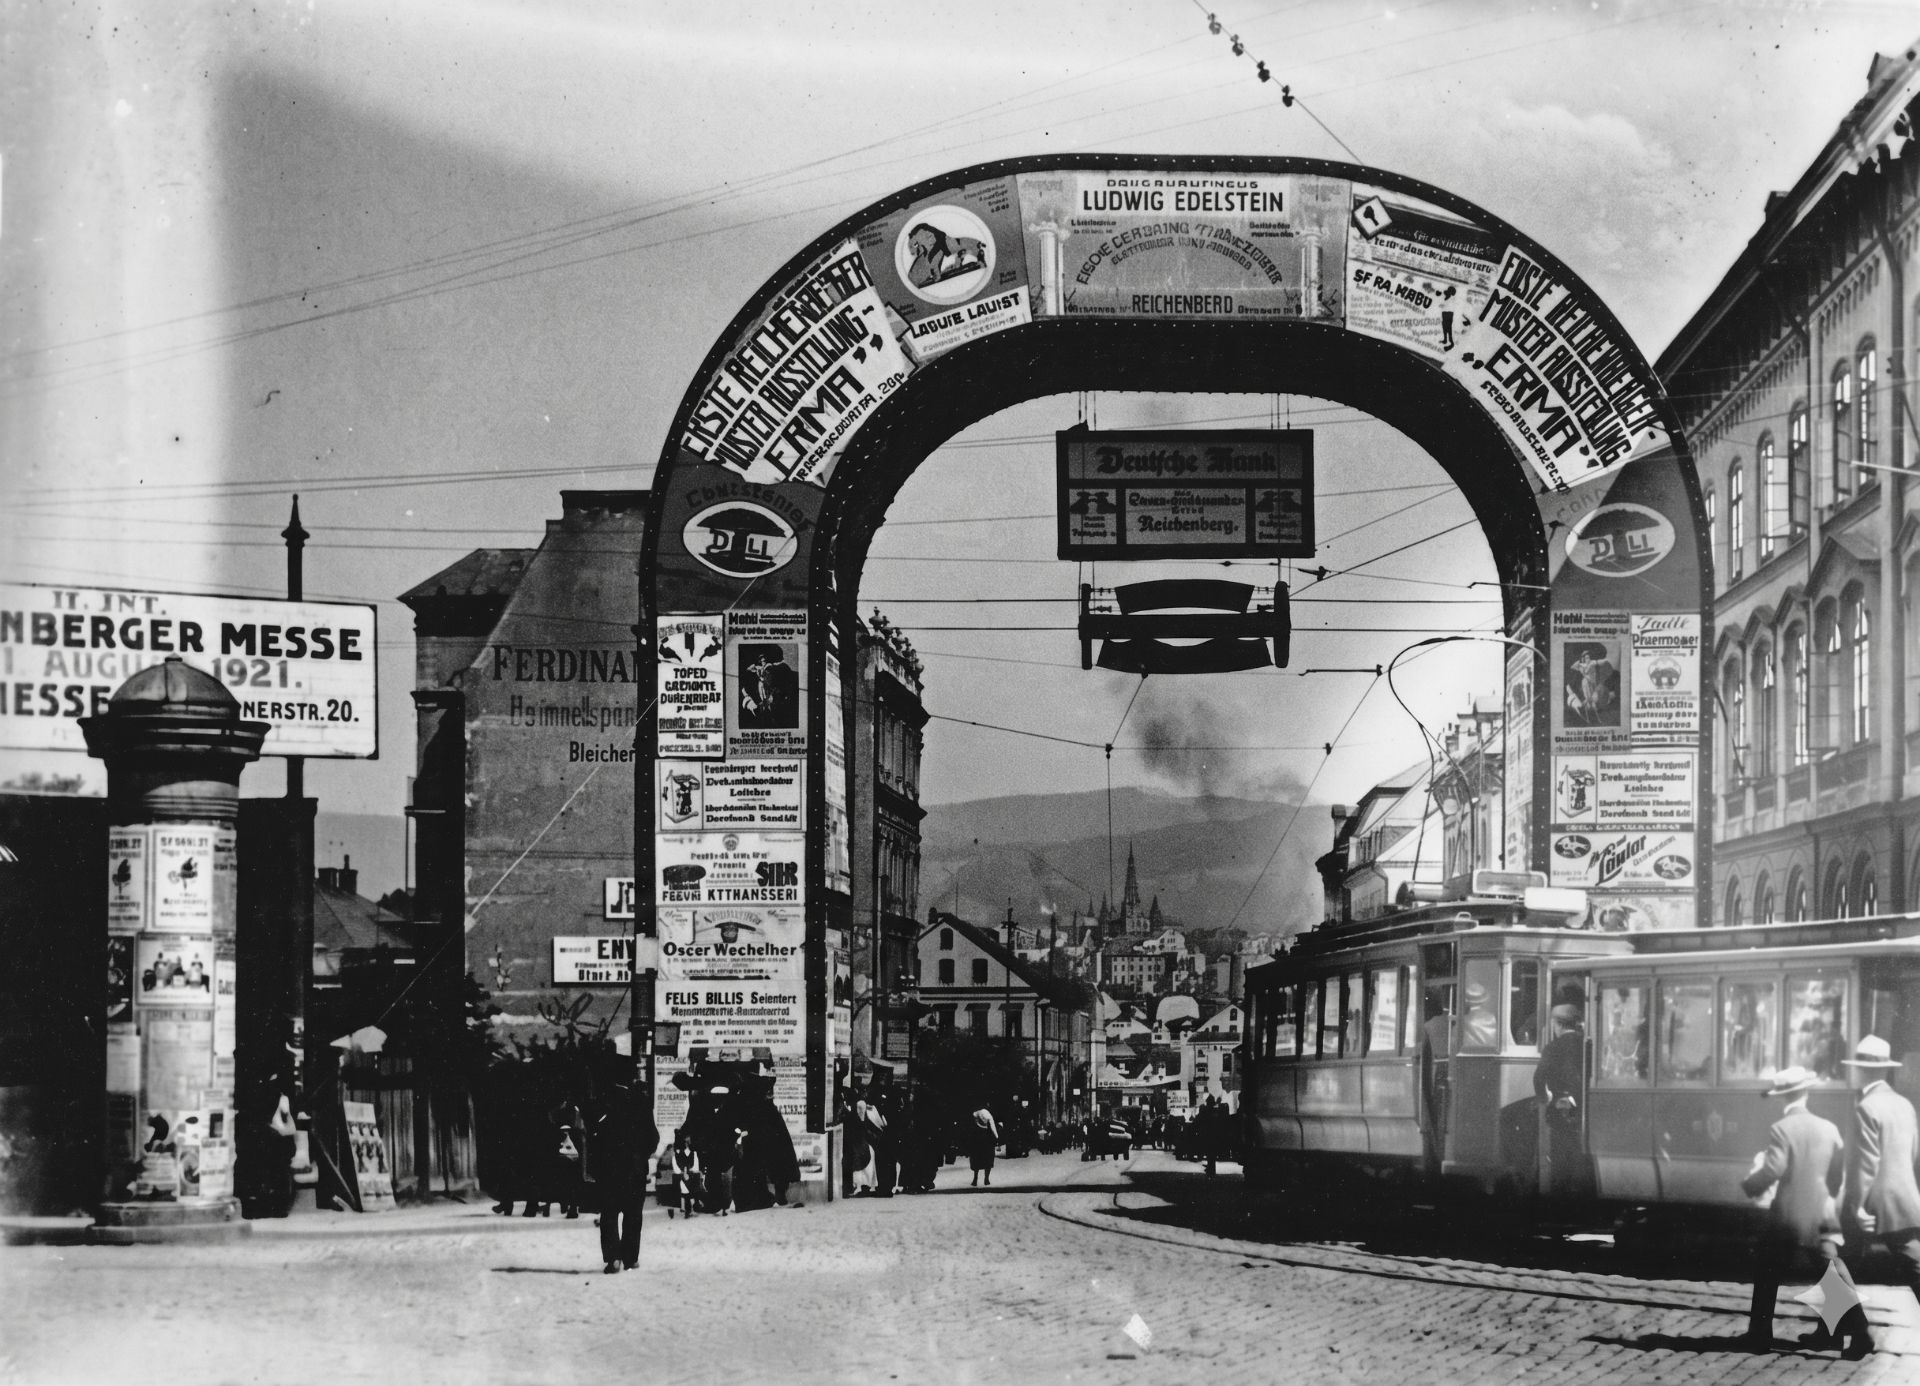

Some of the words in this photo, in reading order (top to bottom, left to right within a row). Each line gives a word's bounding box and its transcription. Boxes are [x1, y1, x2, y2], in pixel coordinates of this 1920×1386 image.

[1083, 190, 1164, 211] LUDWIG
[1175, 190, 1284, 212] EDELSTEIN
[221, 622, 363, 661] MESSE
[665, 992, 699, 1005] FELIS
[706, 992, 743, 1005] BILLIS
